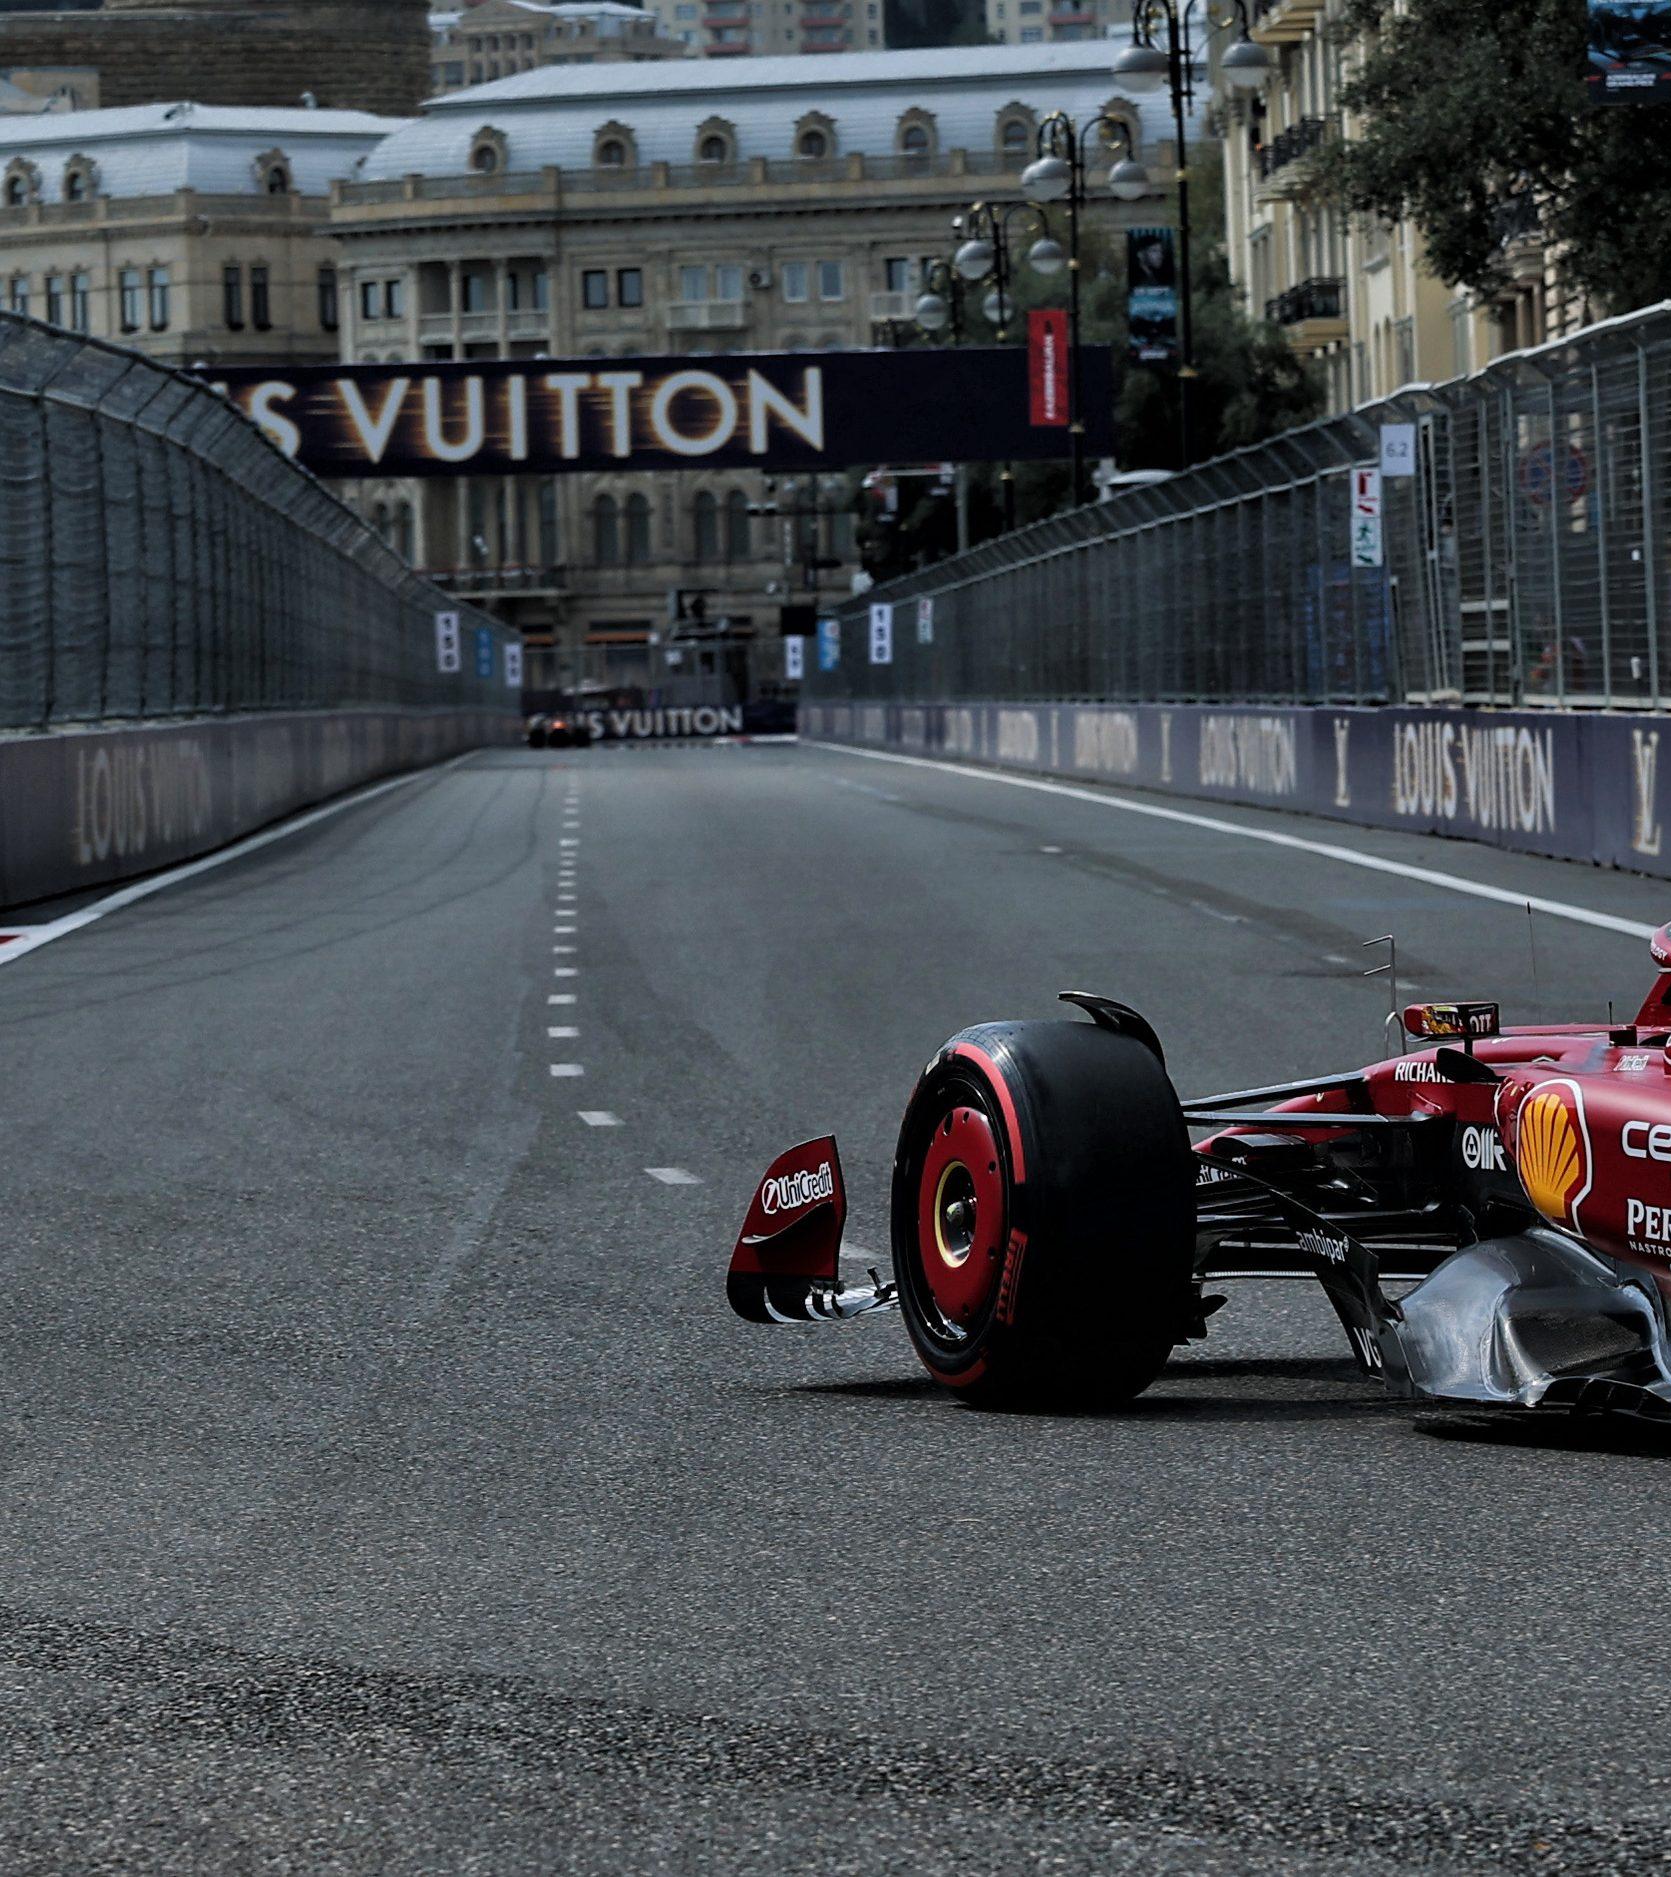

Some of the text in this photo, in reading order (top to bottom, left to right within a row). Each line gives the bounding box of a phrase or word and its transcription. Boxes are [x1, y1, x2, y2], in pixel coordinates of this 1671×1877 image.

[337, 366, 825, 464] VUITTON
[610, 705, 744, 738] VUITTON
[1394, 720, 1555, 834] LOUIS VUITTON
[1395, 1062, 1455, 1084] RICHA
[777, 1162, 834, 1210] UniCredit
[1353, 1327, 1383, 1369] VG
